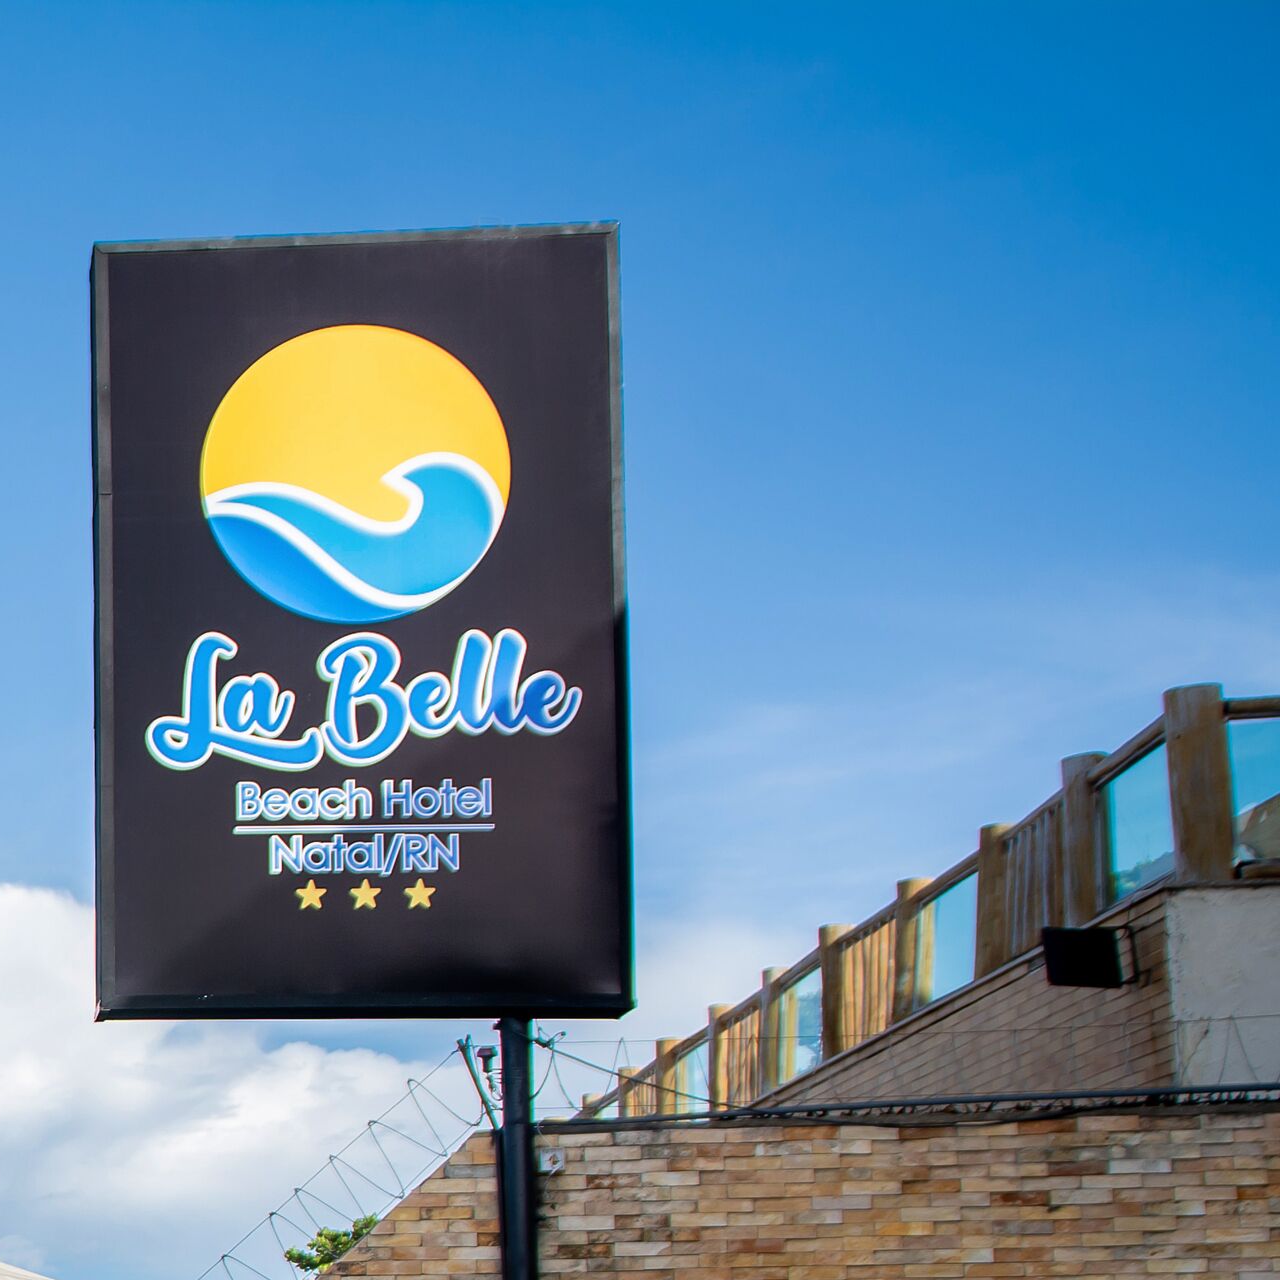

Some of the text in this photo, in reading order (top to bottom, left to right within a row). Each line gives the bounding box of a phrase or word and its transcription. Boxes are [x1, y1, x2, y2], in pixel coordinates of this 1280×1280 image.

[146, 629, 581, 770] La Belle
[235, 778, 493, 822] Beach Hotel
[269, 833, 459, 876] Natal/RN
